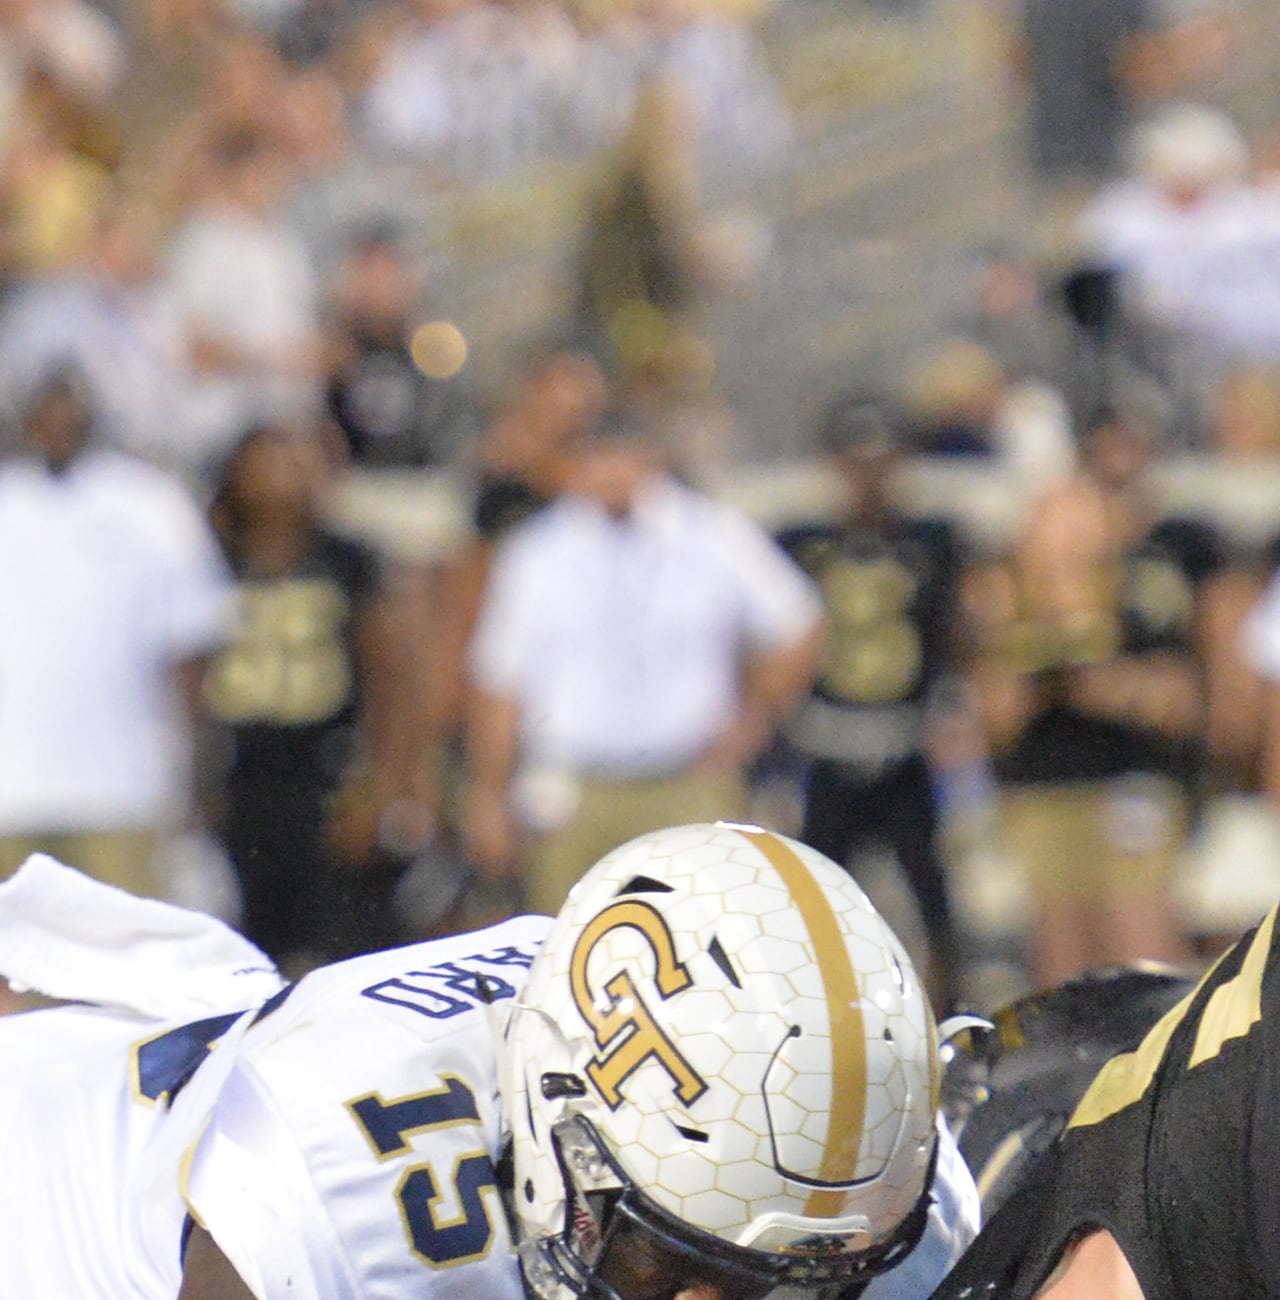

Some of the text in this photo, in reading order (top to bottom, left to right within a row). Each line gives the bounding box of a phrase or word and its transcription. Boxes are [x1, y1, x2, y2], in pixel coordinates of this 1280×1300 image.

[360, 940, 542, 1020] ARD
[569, 899, 709, 1112] GT
[344, 1071, 500, 1270] 15
